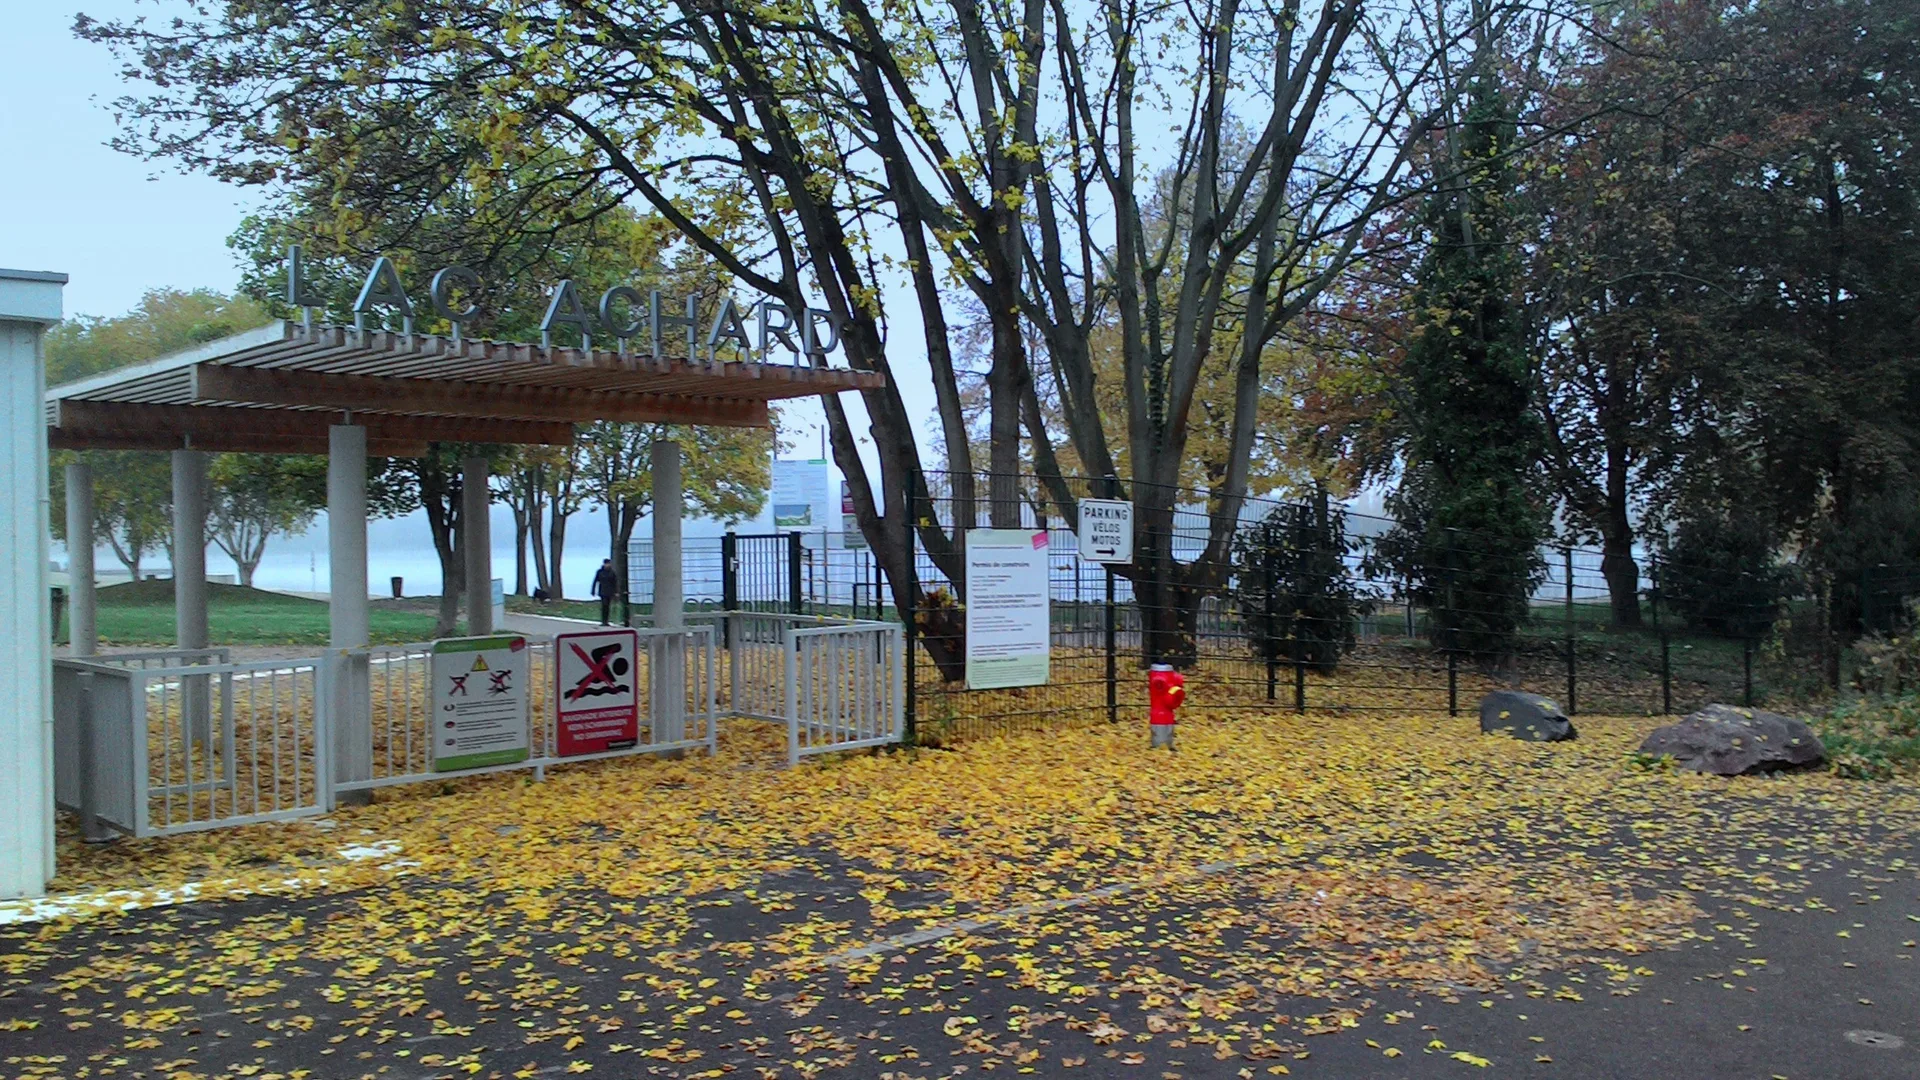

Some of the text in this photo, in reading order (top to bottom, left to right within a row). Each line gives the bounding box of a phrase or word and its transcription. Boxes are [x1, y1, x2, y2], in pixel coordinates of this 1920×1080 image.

[287, 244, 841, 355] LAC ACHARD
[1084, 506, 1128, 521] PARKING
[1092, 520, 1121, 533] VÉLOS
[1091, 534, 1121, 546] MOTOS
